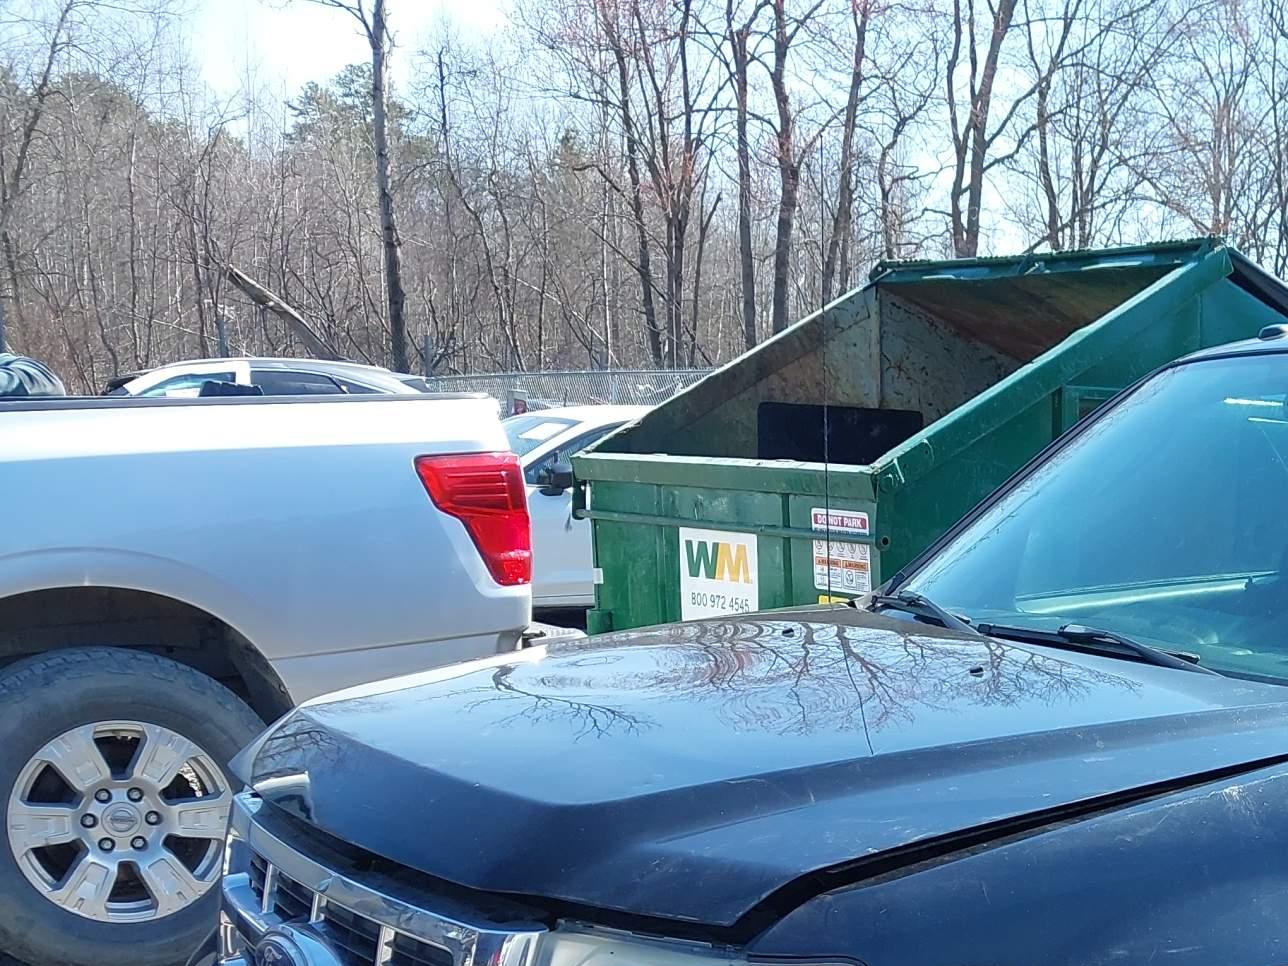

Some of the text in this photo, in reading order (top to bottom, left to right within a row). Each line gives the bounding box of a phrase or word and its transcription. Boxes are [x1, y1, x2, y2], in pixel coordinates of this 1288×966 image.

[817, 514, 862, 528] DO NOT PARK
[685, 540, 751, 584] WM
[691, 592, 750, 613] 800 972 4545
